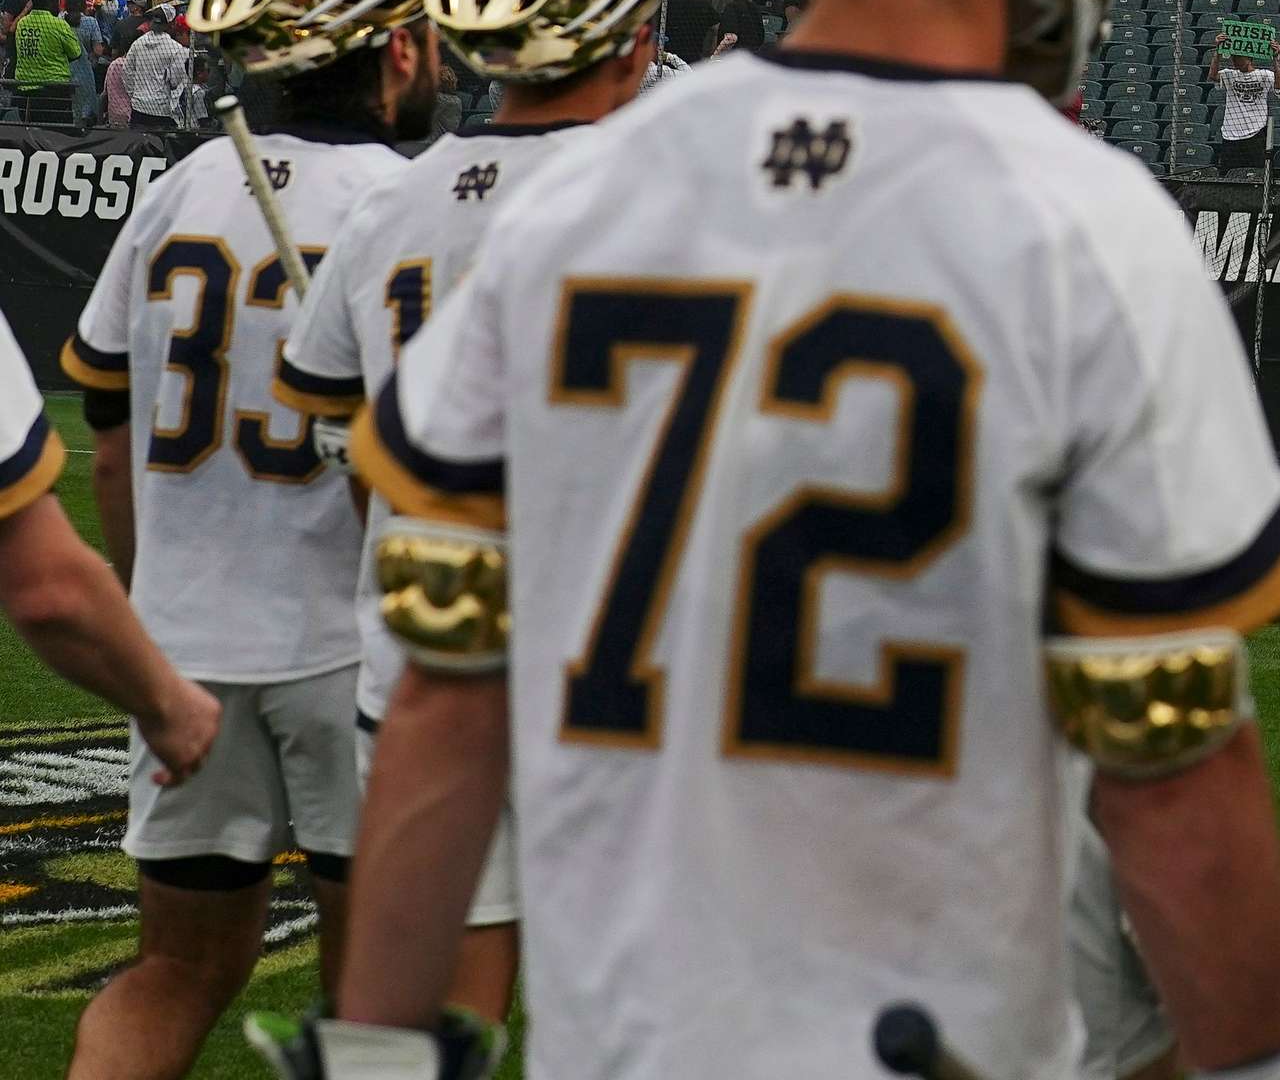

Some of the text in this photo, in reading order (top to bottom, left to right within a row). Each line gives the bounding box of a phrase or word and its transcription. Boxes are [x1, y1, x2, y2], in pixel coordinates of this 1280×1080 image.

[20, 28, 41, 38] CSC
[1224, 24, 1273, 41] IRISH
[546, 276, 985, 781] 72
